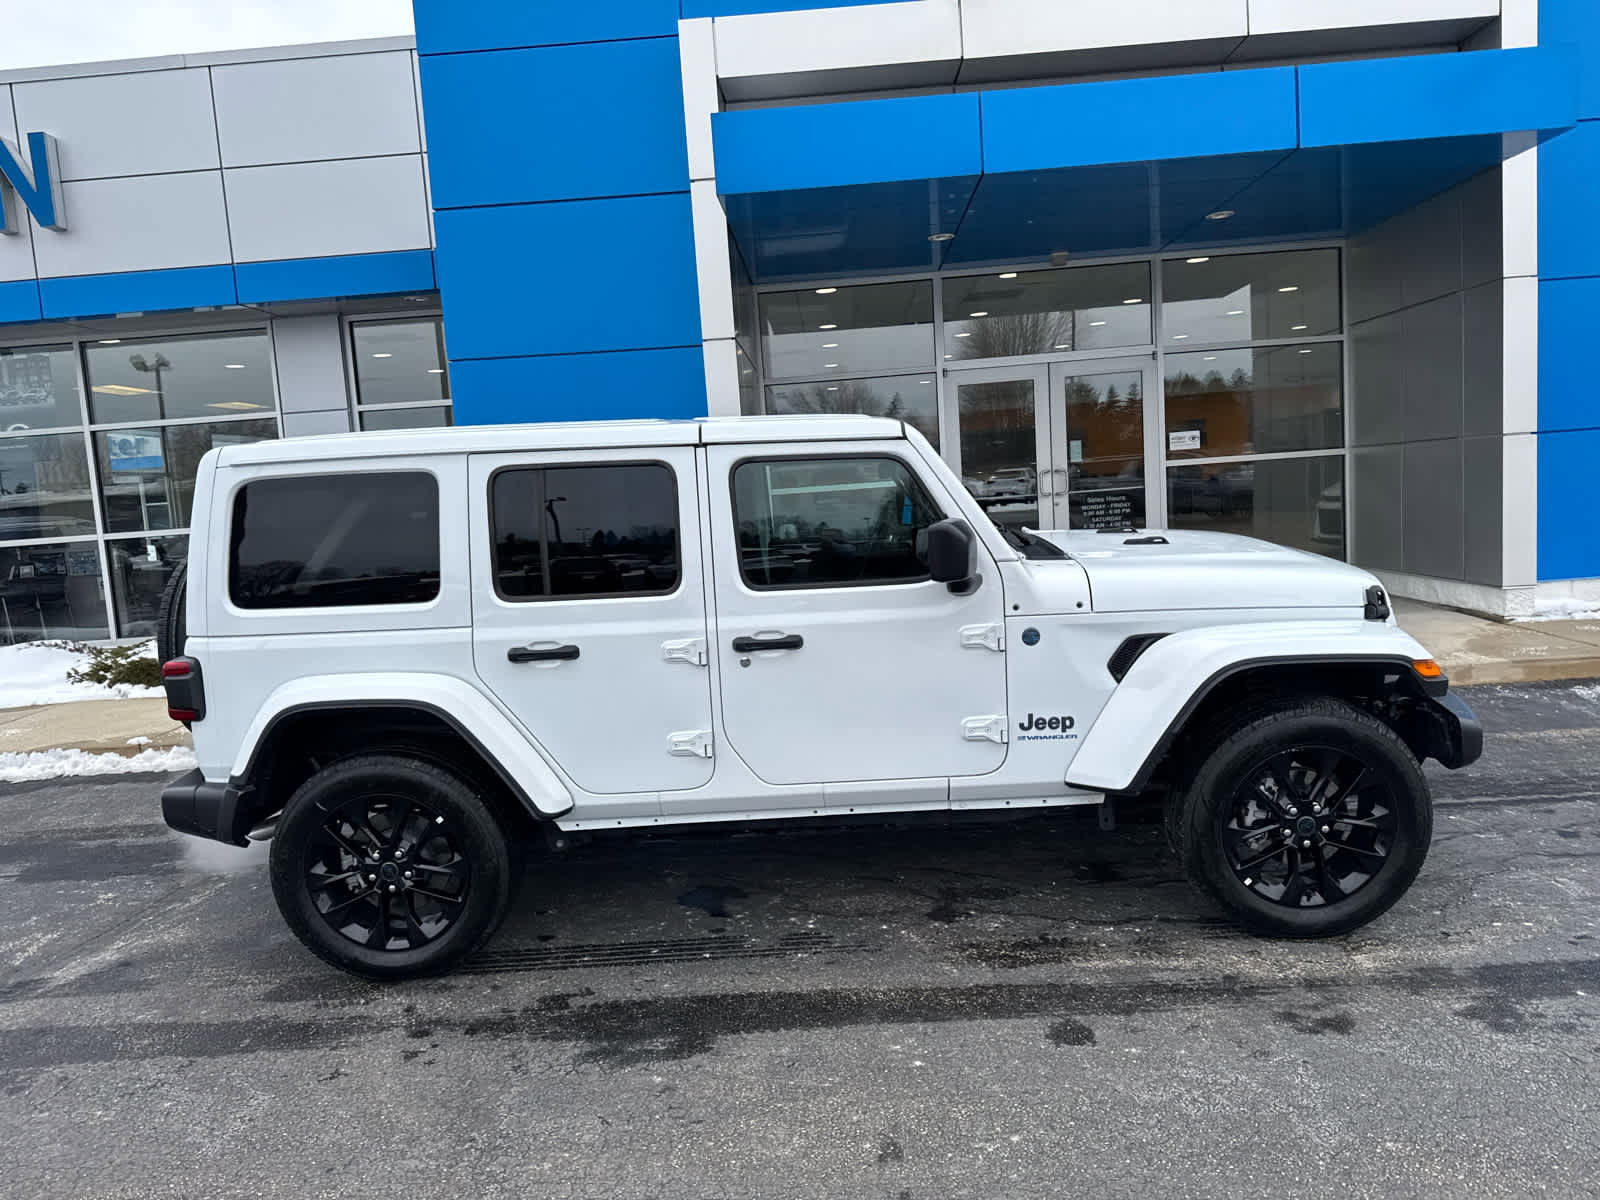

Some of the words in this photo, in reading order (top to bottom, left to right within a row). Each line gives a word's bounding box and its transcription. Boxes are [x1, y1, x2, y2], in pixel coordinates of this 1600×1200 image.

[1081, 503, 1106, 511] MONDAY
[1091, 515, 1122, 523] SATURDAY
[1018, 712, 1075, 733] Jeep
